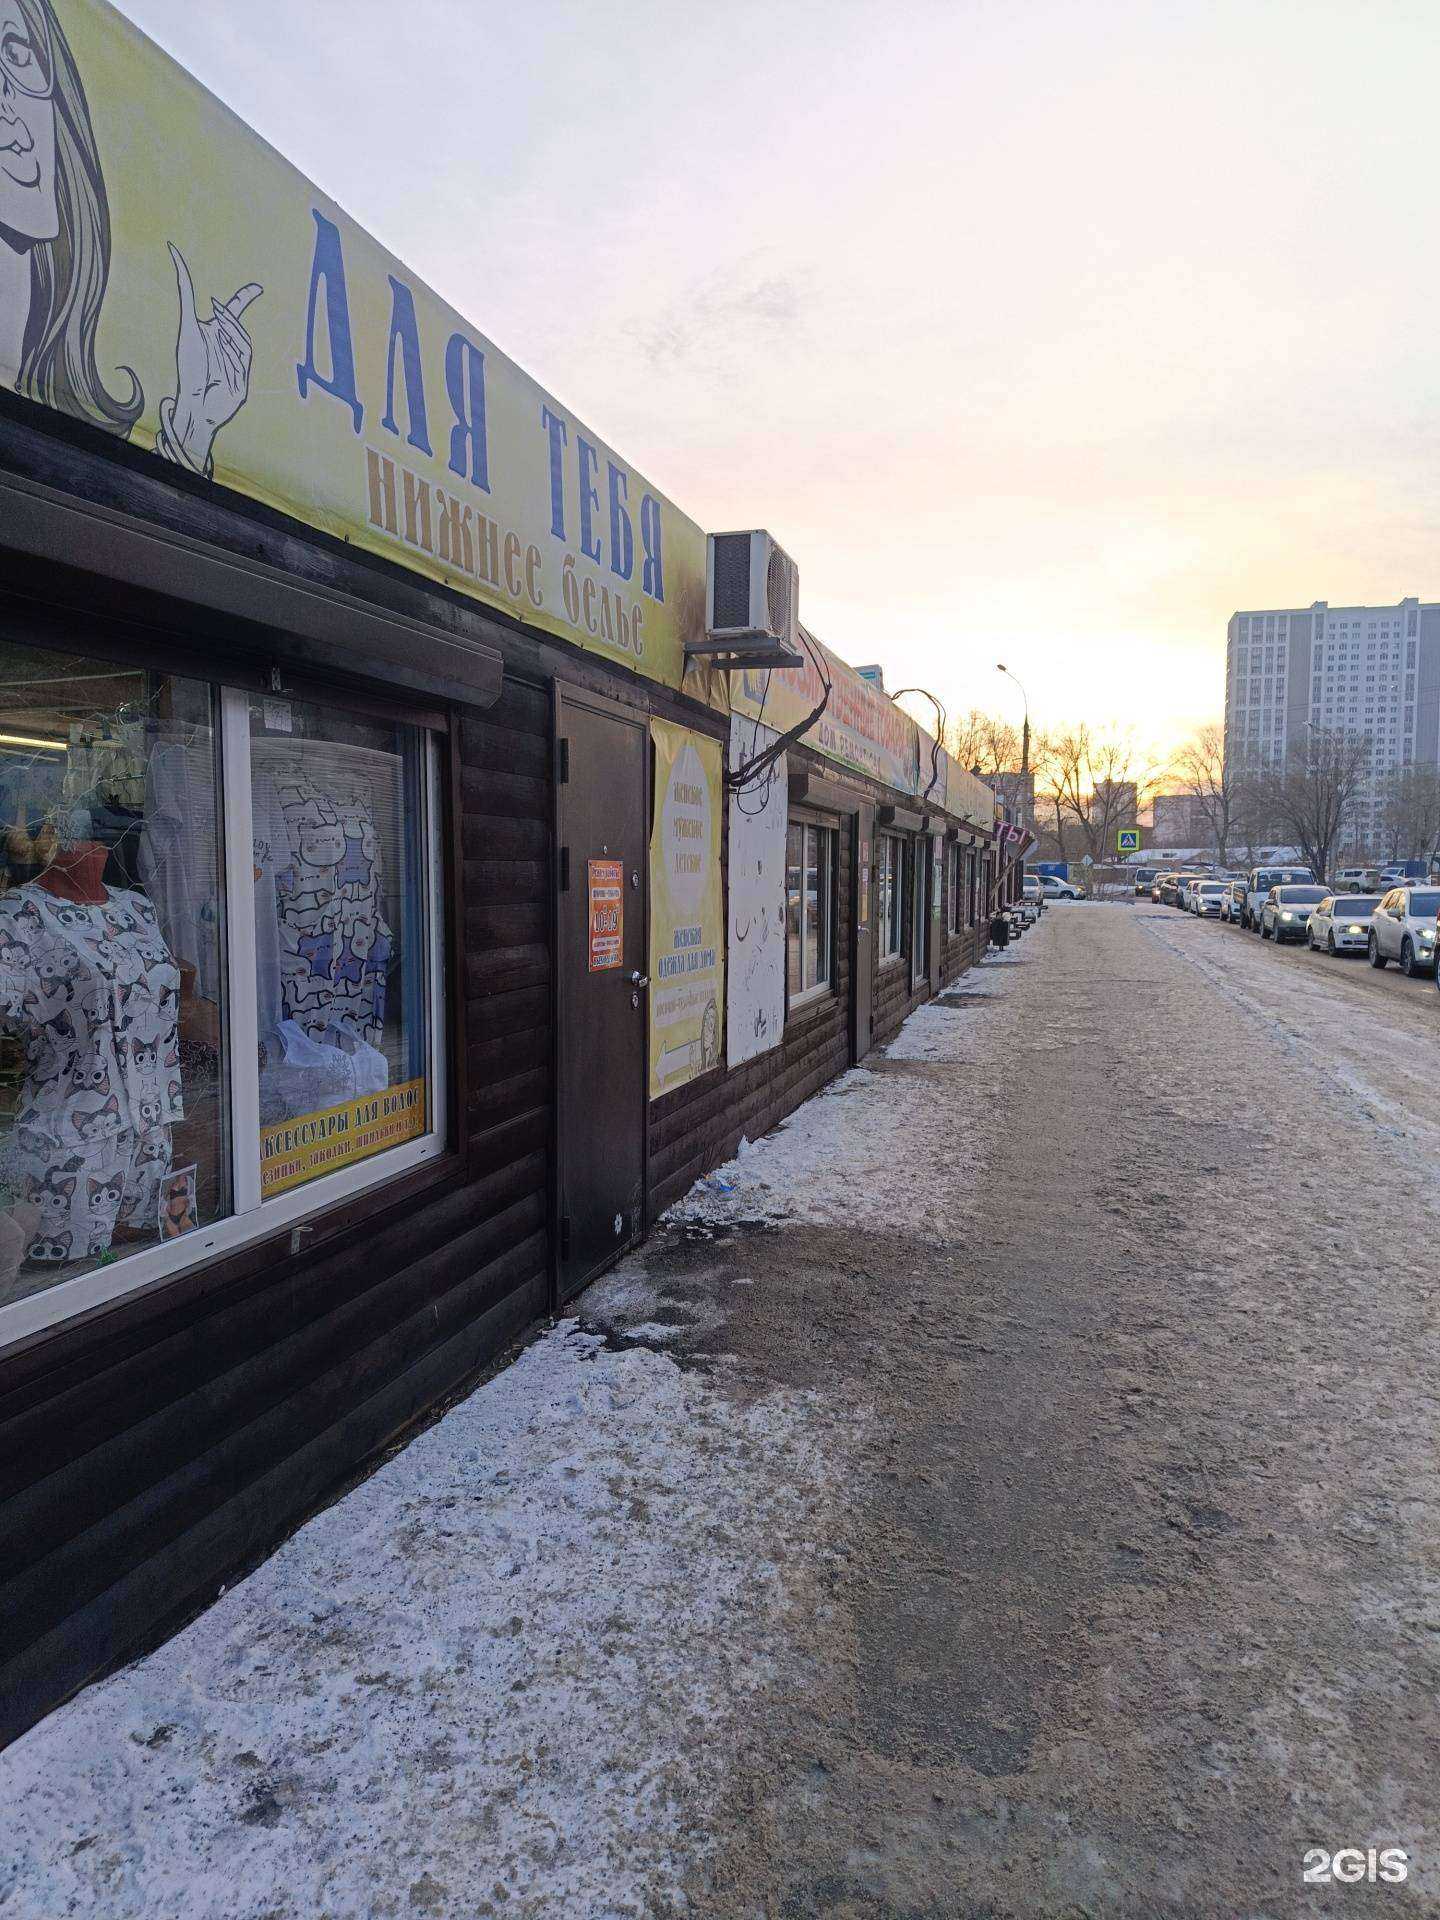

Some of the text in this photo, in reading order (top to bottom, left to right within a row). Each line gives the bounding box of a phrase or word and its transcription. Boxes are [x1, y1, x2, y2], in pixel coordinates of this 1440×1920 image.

[297, 207, 665, 603] ДЛЯ ТЕБЯ
[366, 447, 643, 656] нижнее белье
[260, 1110, 349, 1161] КСЕССУАРЫ
[355, 1101, 379, 1128] ДЛЯ
[262, 1158, 306, 1186] езинки,
